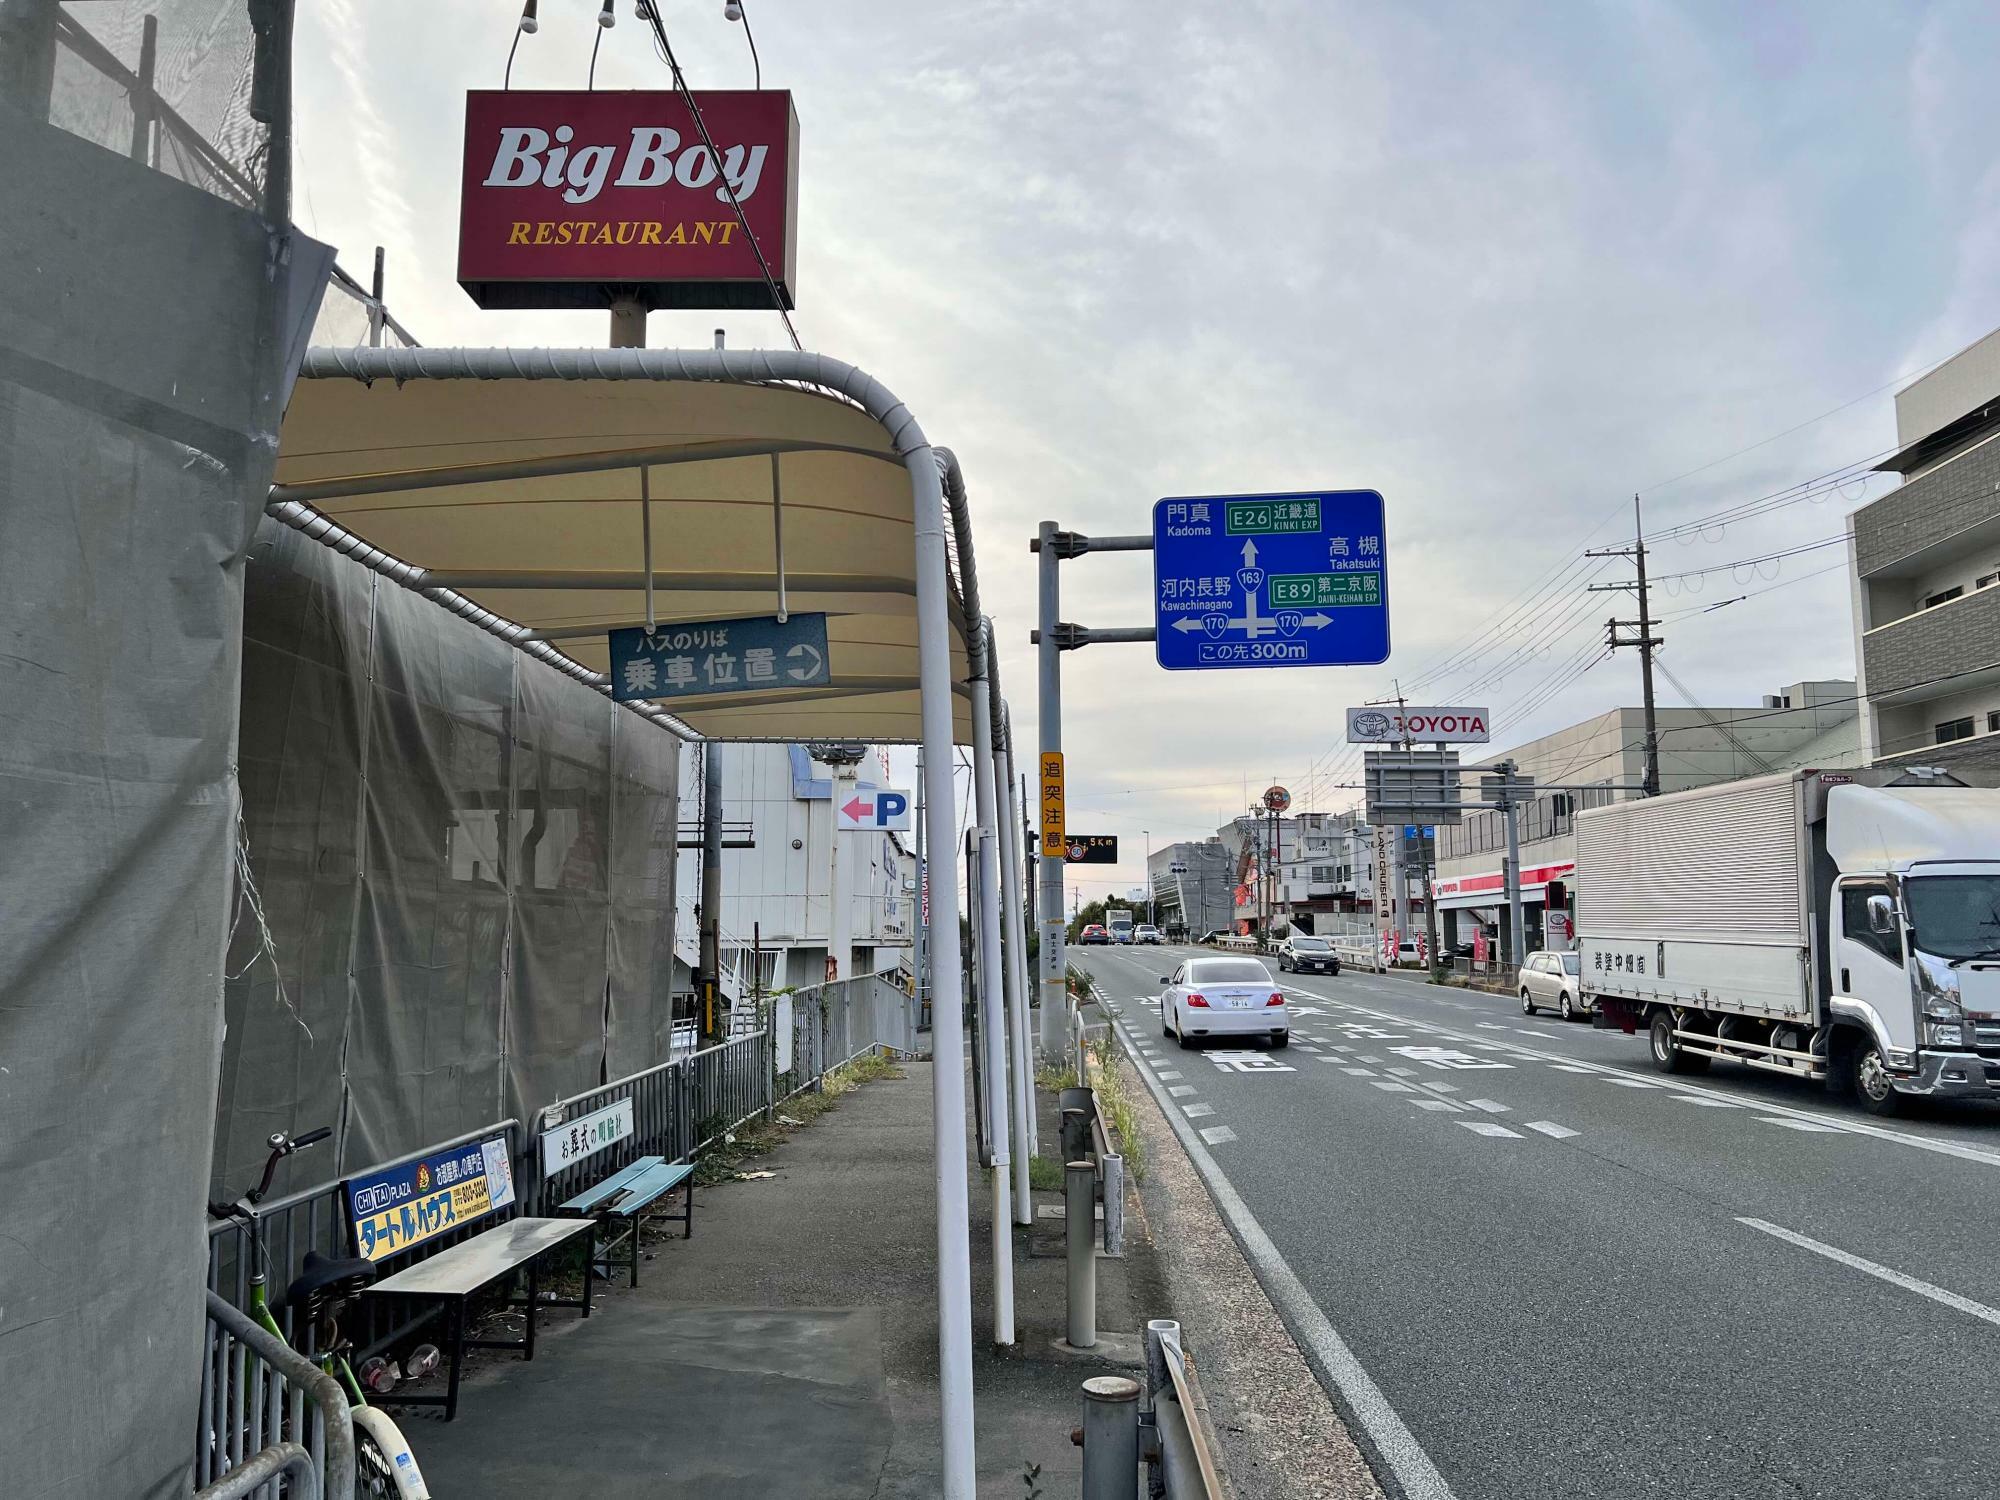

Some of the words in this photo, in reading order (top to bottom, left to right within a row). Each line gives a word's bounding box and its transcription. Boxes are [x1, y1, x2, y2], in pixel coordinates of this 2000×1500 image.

[482, 125, 616, 204] Big
[614, 127, 768, 203] Boy
[506, 222, 740, 245] RESTAURANT
[1167, 503, 1211, 523] 門真
[1233, 510, 1267, 526] E26
[1273, 503, 1318, 519] 近畿道
[1167, 526, 1211, 537] Kadoma
[1273, 521, 1299, 530] KINKI
[1301, 520, 1318, 530] EXP
[1329, 536, 1379, 556] 高槻
[1329, 558, 1380, 570] Takatsuki
[1241, 572, 1260, 584] 163
[1317, 576, 1377, 593] 第二京阪
[1161, 577, 1231, 598] 河内長野
[1277, 584, 1311, 599] E89
[1161, 600, 1233, 611] Kawachinagano
[1365, 593, 1378, 603] EXP
[1205, 618, 1224, 630] 170
[1280, 615, 1299, 628] 170
[636, 628, 729, 653] バスのりば
[624, 648, 778, 692] 乗車位置
[1394, 716, 1486, 733] TOYOTA
[877, 793, 907, 826] P
[1044, 761, 1063, 849] 追突注意
[391, 1182, 412, 1200] PLAZA
[360, 1190, 456, 1257] タートルハウス
